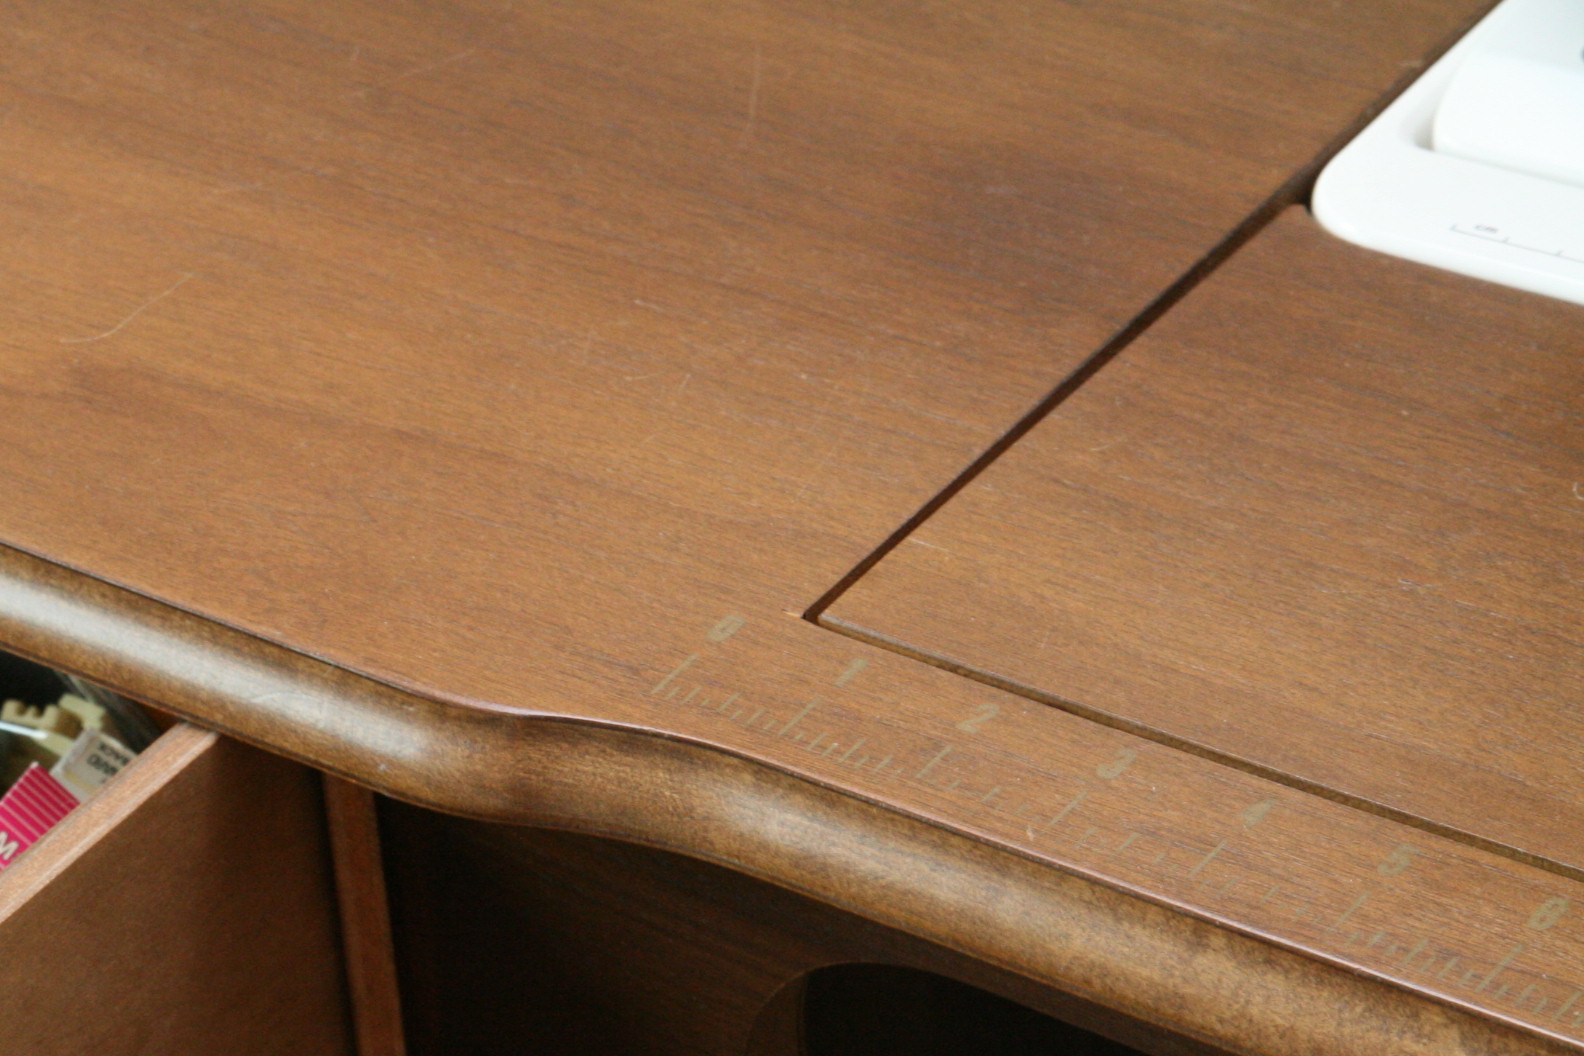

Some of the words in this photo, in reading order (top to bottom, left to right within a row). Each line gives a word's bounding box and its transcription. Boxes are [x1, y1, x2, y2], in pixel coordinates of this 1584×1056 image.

[835, 659, 869, 687] 1
[958, 704, 1001, 733] 2
[1096, 749, 1137, 779] 3
[1240, 799, 1276, 829] 4
[1378, 844, 1419, 877] 5
